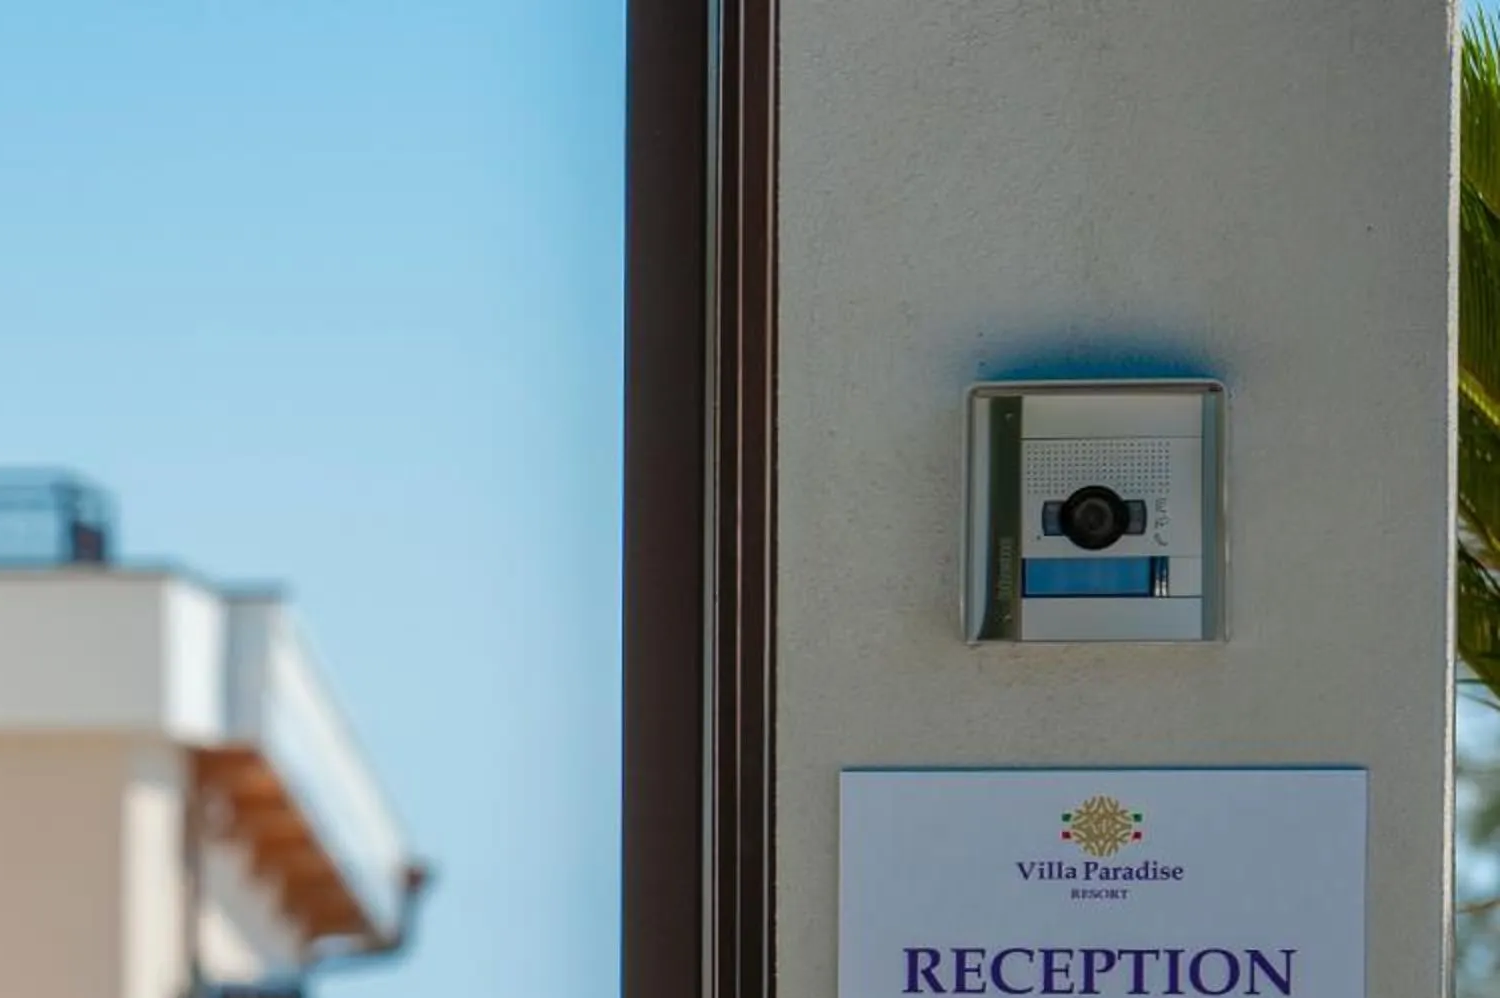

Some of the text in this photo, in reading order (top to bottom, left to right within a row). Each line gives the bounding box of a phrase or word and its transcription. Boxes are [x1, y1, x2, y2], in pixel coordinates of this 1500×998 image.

[1016, 860, 1184, 881] Villa Paradise
[1070, 888, 1129, 900] RESORT
[902, 947, 1297, 996] RECEPTION
